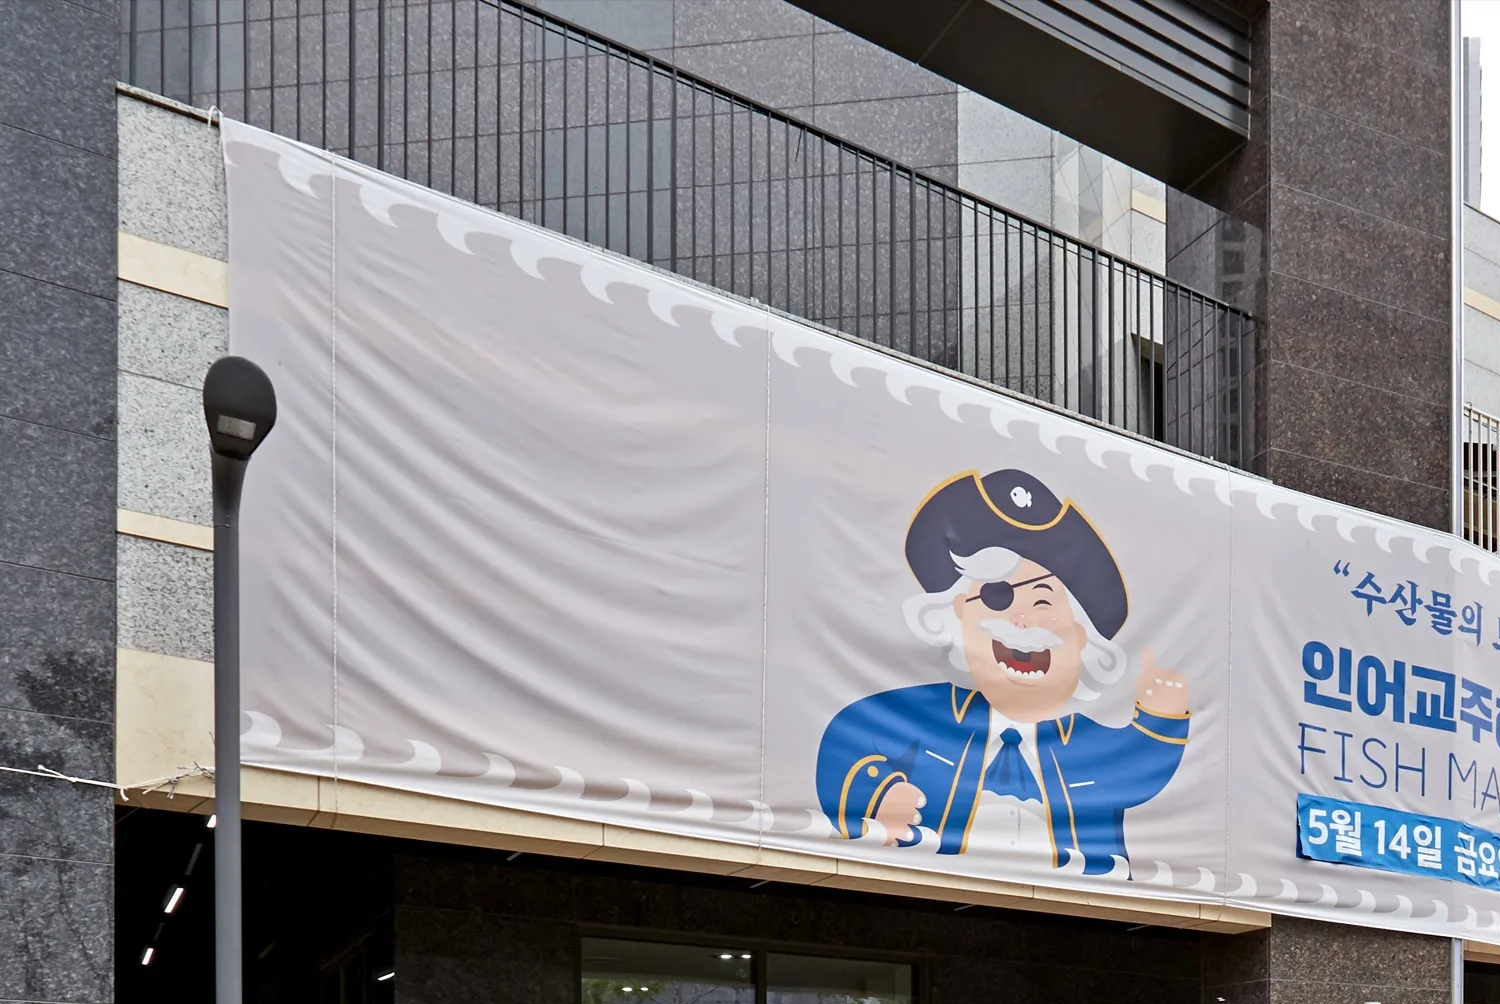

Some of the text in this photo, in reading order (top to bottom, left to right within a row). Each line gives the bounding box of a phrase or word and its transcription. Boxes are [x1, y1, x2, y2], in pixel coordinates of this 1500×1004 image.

[1298, 722, 1427, 797] FISH
[1308, 808, 1362, 857] 5월
[1374, 819, 1443, 870] 14일
